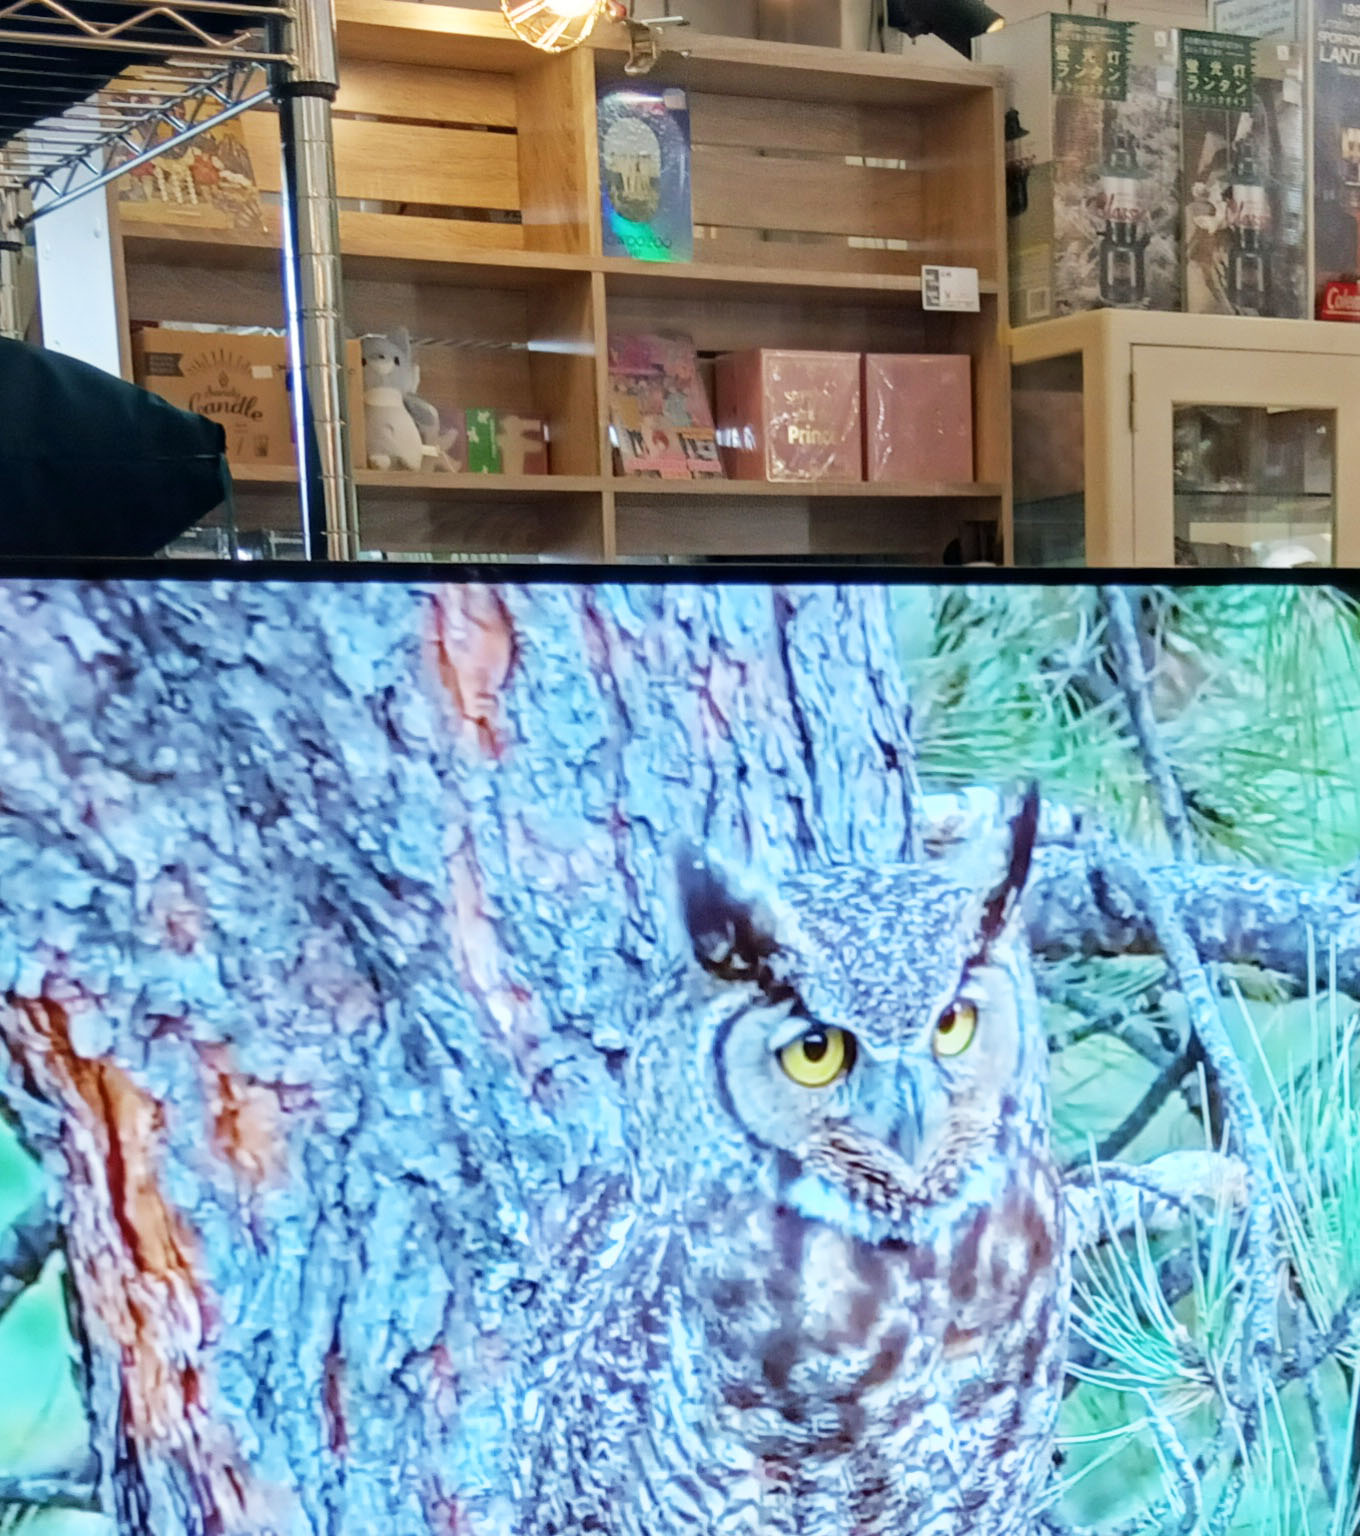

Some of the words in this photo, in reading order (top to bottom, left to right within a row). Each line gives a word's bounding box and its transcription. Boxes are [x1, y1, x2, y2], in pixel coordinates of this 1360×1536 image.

[1056, 62, 1121, 82] ランタン
[1187, 76, 1248, 95] ランタン
